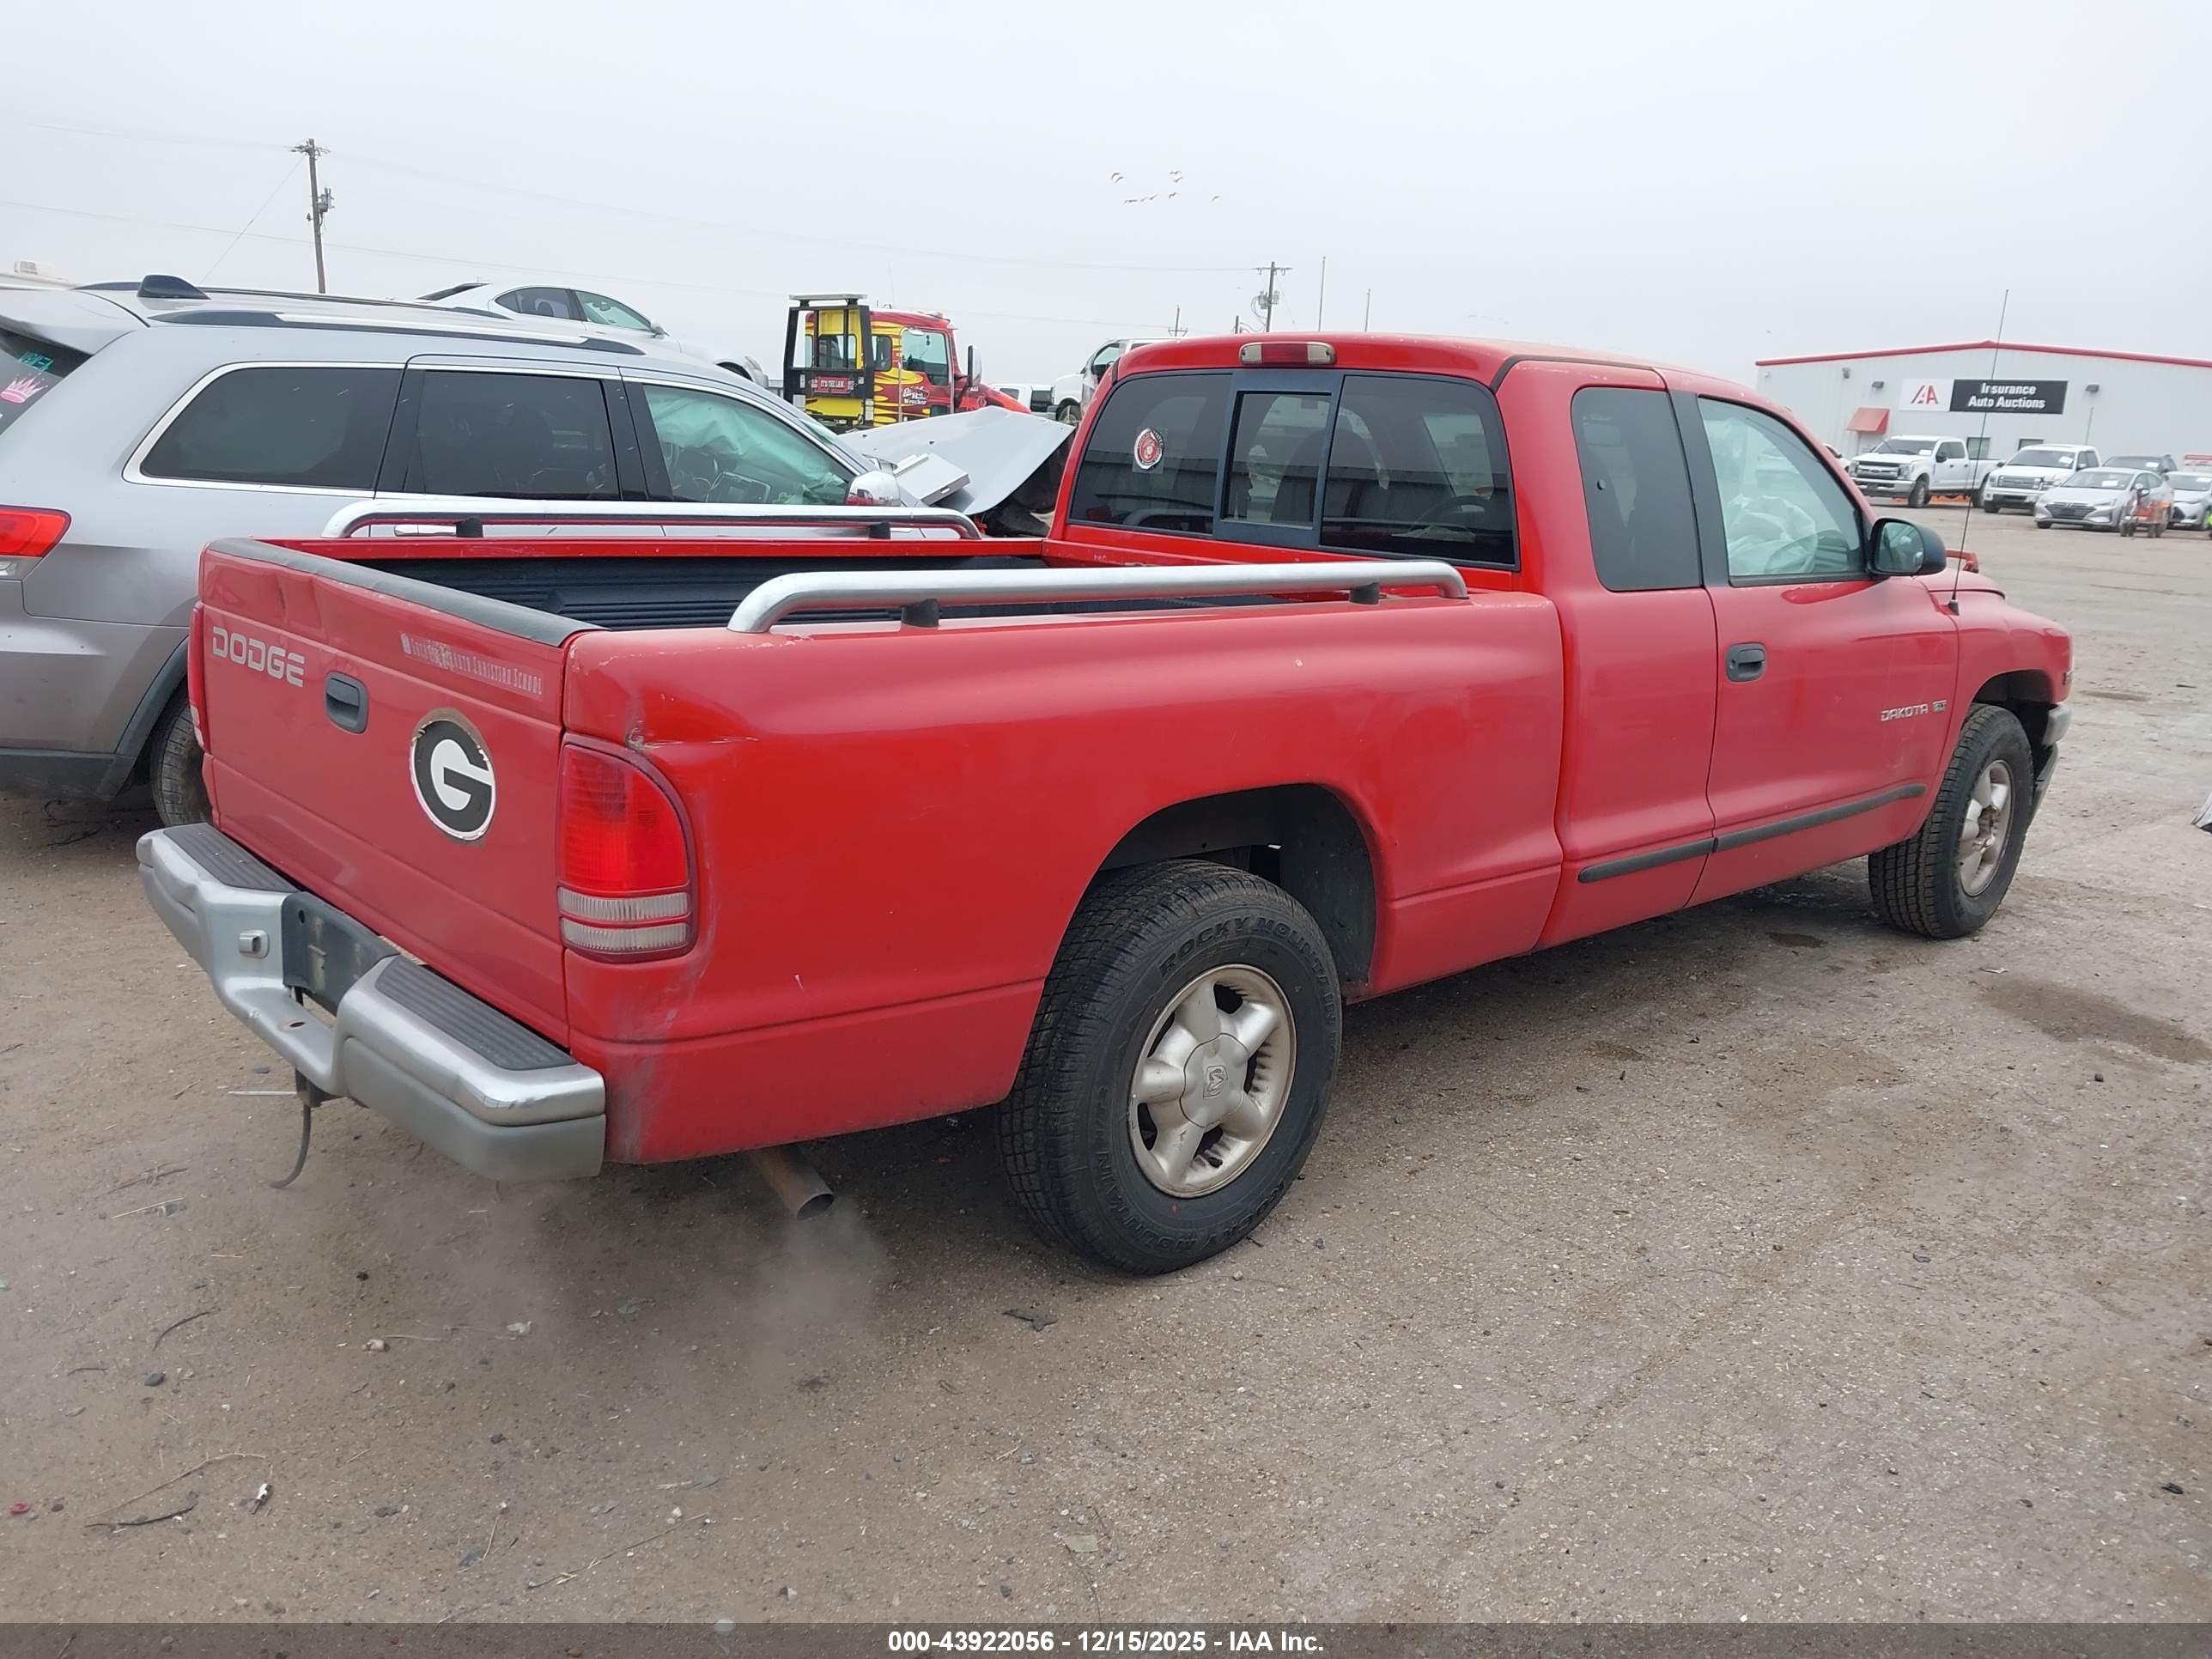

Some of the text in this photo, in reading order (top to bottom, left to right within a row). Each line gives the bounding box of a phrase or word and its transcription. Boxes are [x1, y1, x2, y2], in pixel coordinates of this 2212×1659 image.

[1980, 382, 2037, 395] Insurance
[1967, 396, 2045, 409] Auto Auctions
[212, 626, 305, 687] DODGE
[1881, 703, 1929, 721] DAKOTA
[1160, 915, 1249, 977] ROCKY
